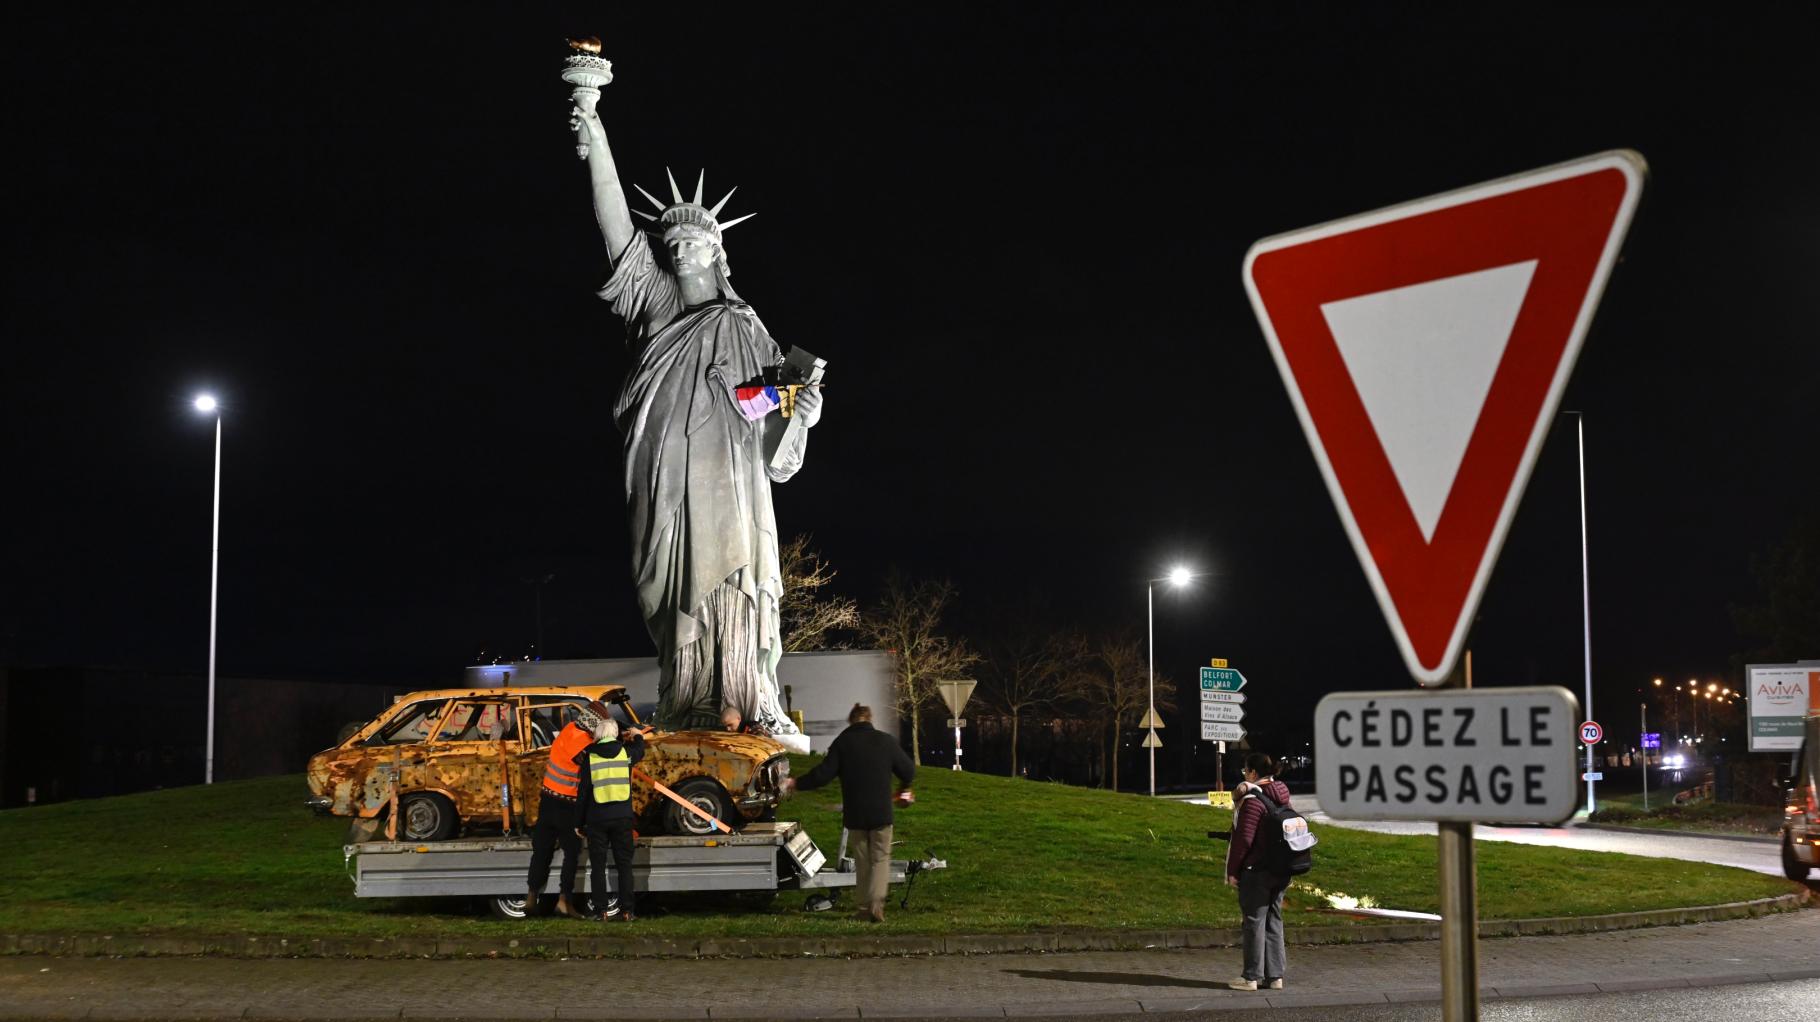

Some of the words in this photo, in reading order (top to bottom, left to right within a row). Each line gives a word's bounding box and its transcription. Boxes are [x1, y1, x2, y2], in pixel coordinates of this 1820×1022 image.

[1203, 671, 1232, 679] BELFORT
[1203, 680, 1231, 688] COLMAR
[1204, 723, 1219, 731] PARC
[1332, 700, 1476, 748] CÉDEZ
[1501, 706, 1552, 747] LE
[1204, 731, 1239, 739] EXPOSITIONS
[1583, 728, 1598, 738] 70
[1339, 764, 1547, 805] PASSAGE
